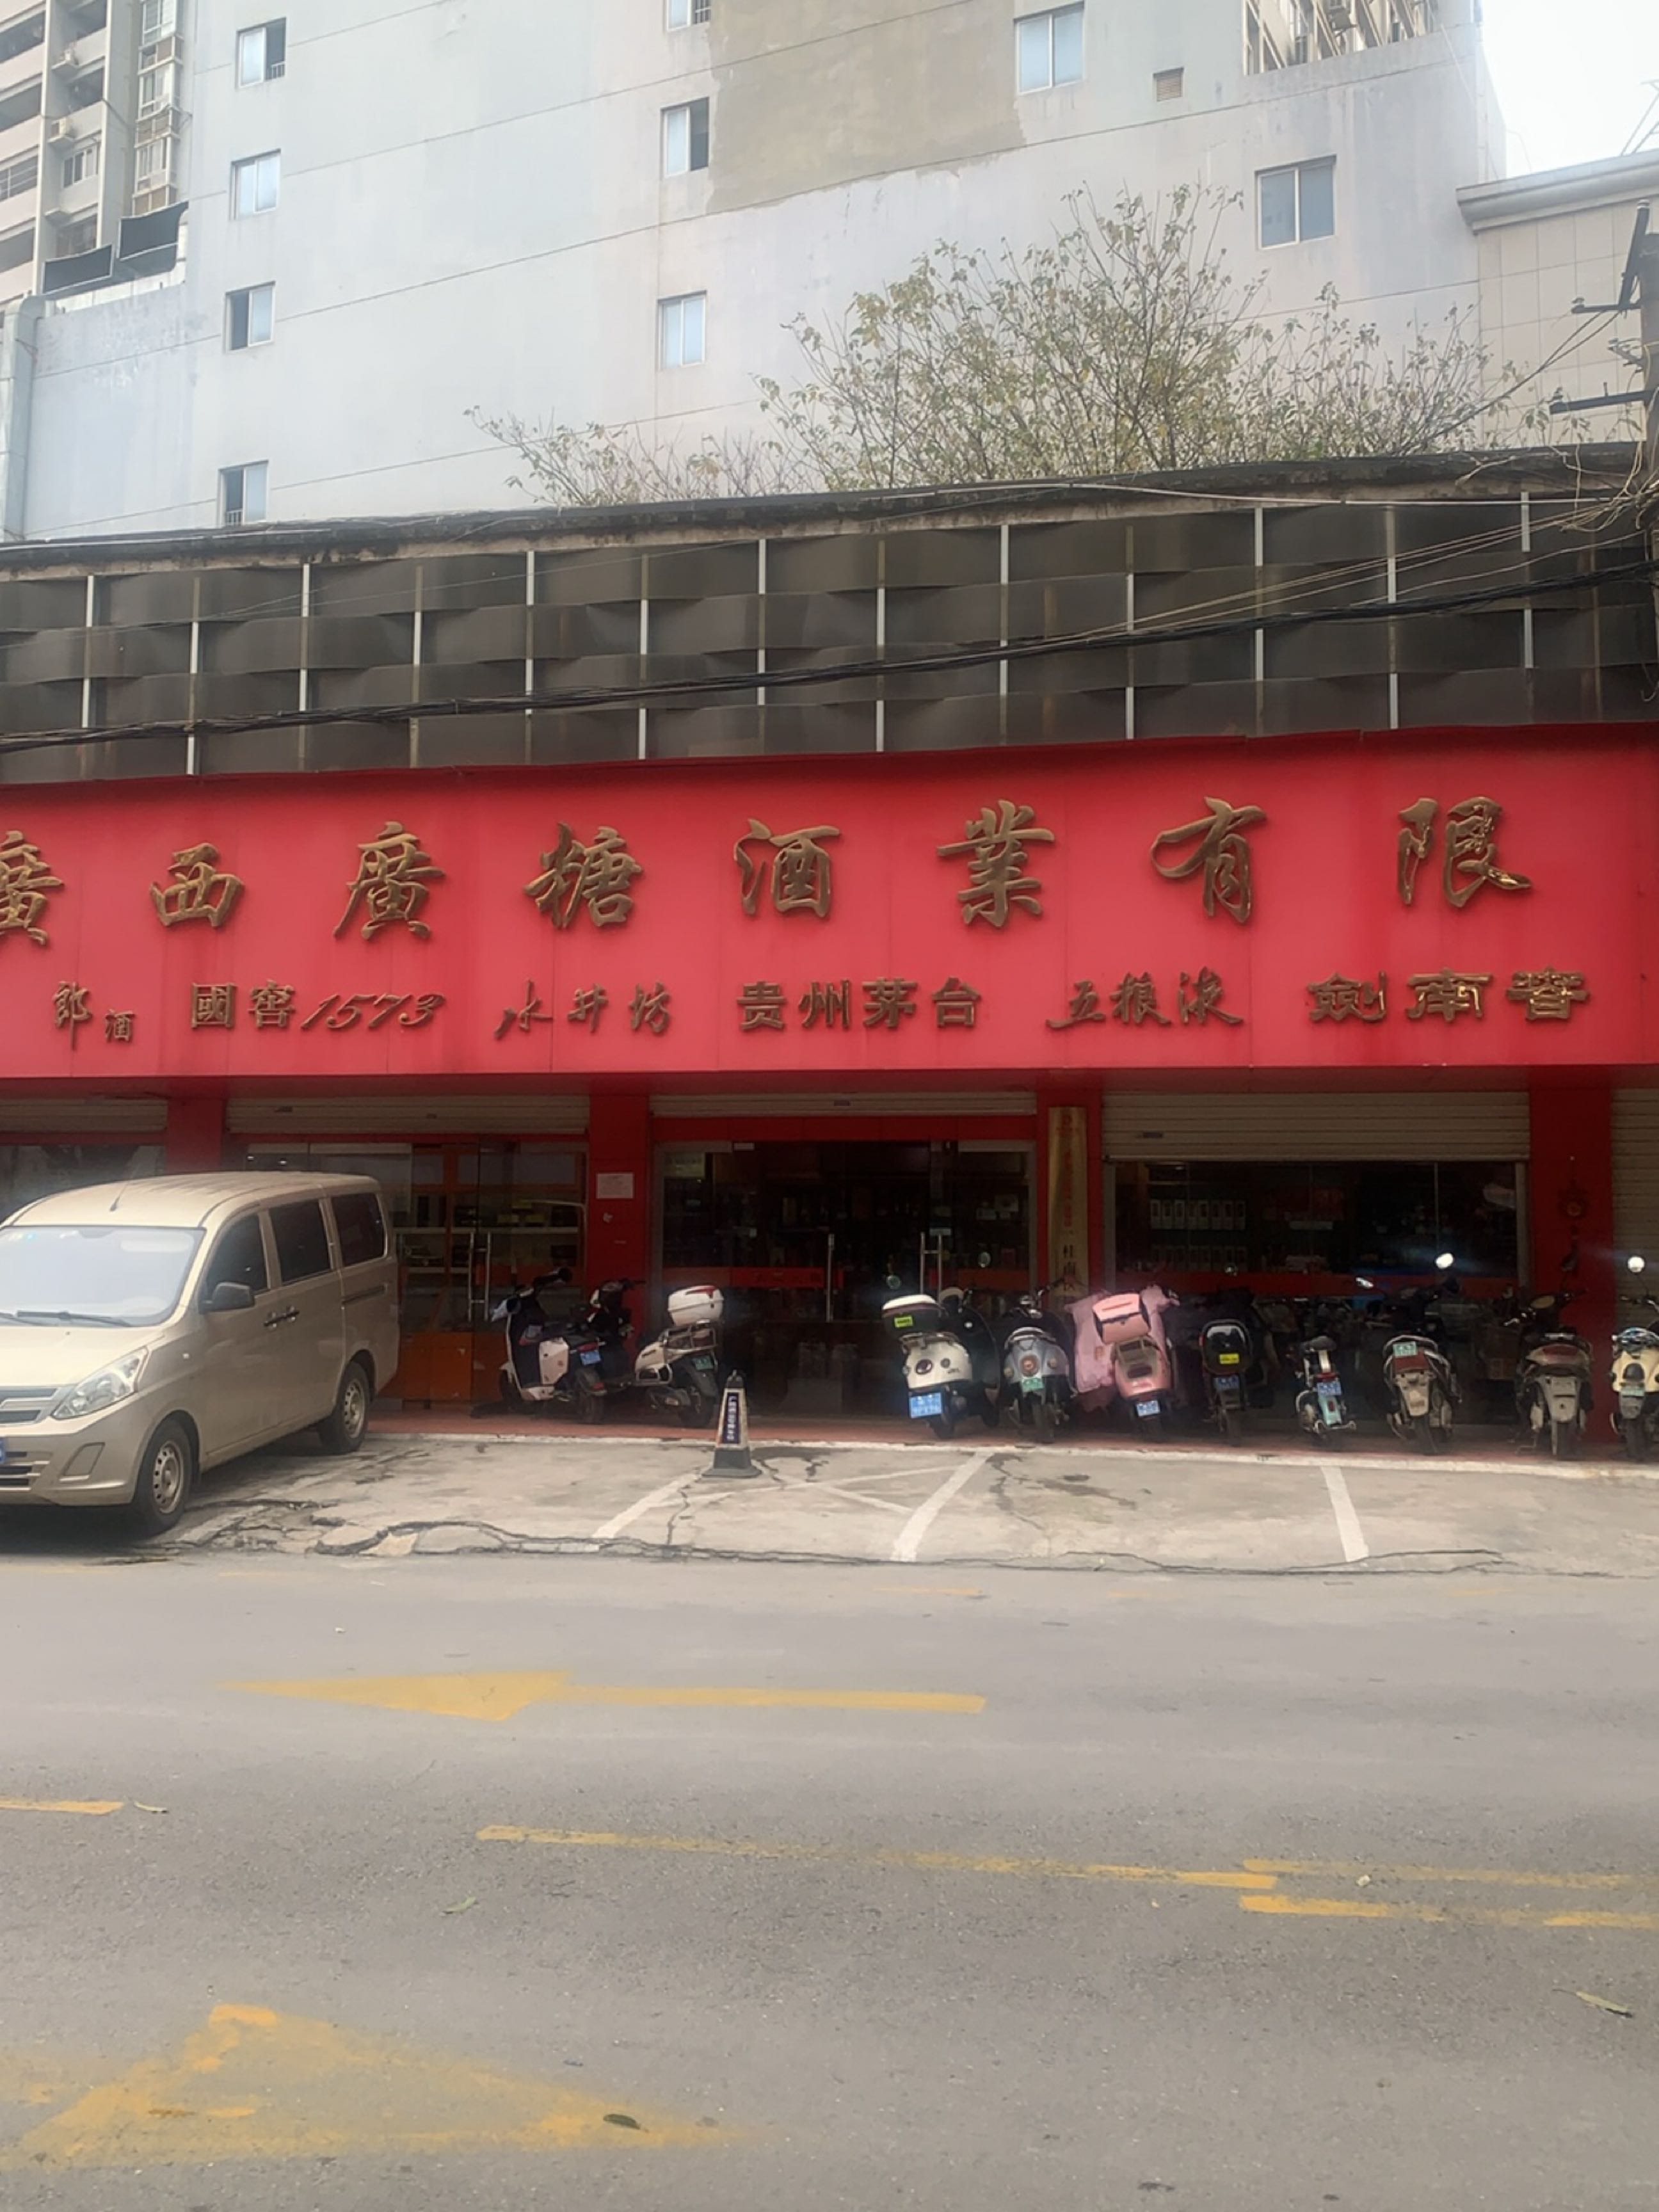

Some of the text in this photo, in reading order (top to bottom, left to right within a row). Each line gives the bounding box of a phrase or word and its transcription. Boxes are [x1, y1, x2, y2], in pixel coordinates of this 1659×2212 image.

[495, 978, 673, 1039] 水井坊
[737, 976, 982, 1031] 贵州茅台
